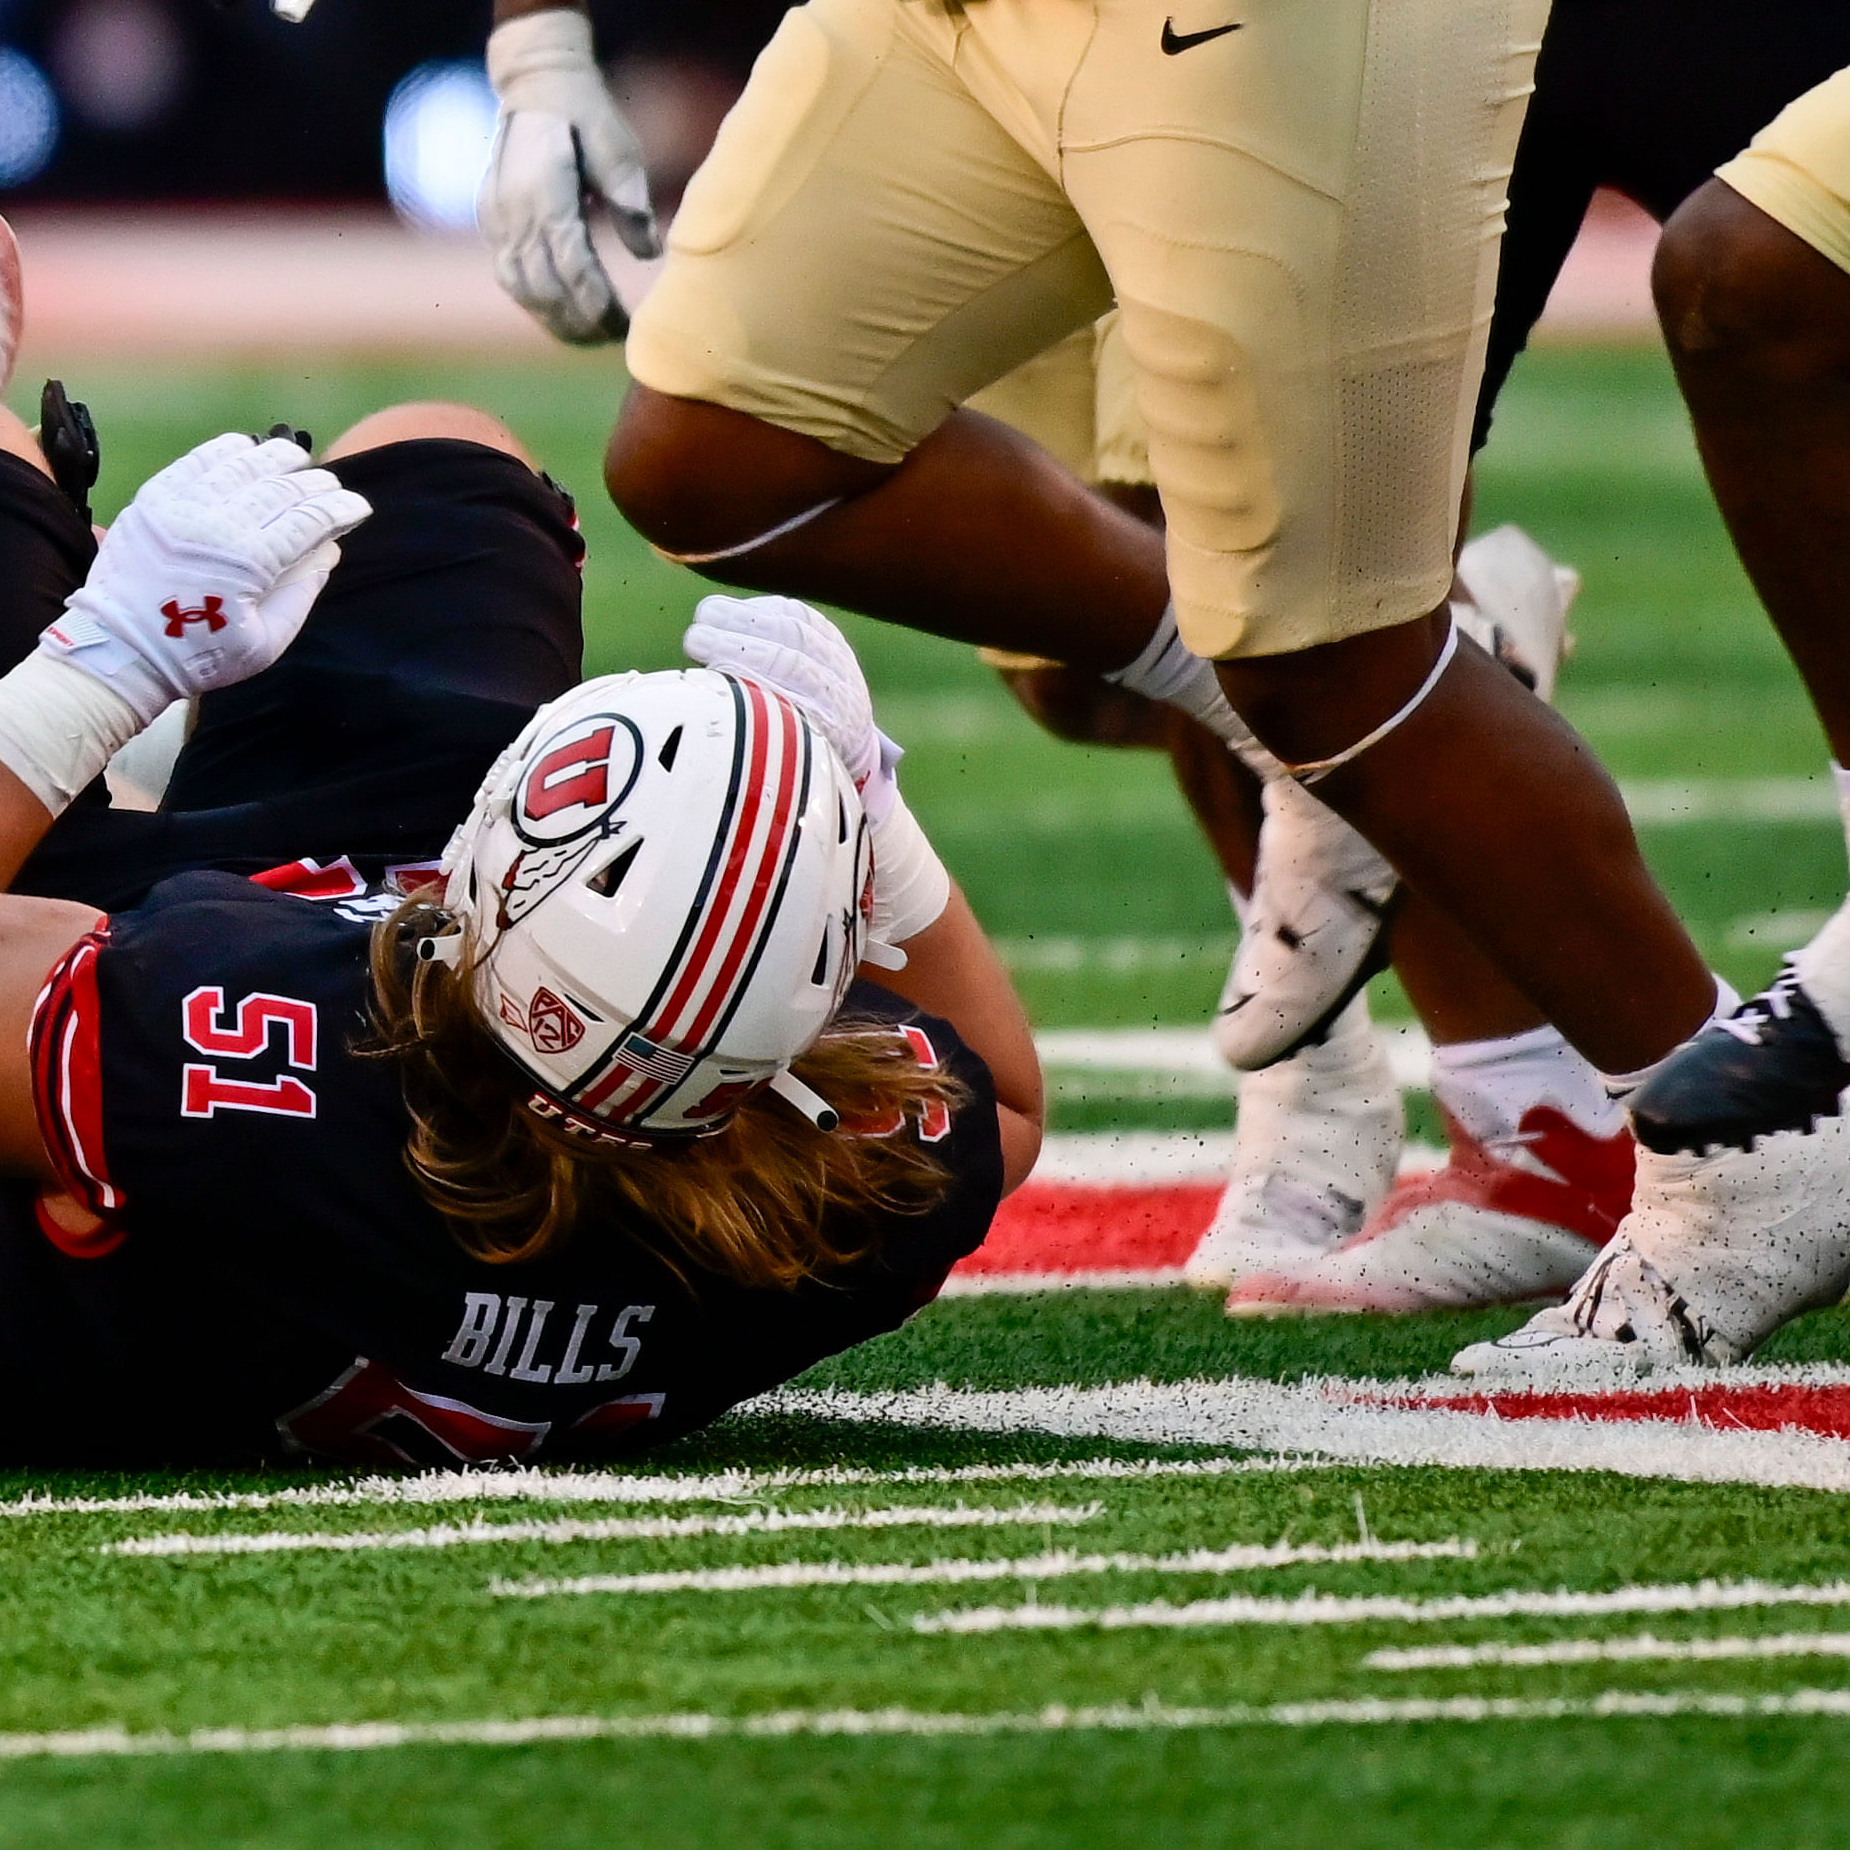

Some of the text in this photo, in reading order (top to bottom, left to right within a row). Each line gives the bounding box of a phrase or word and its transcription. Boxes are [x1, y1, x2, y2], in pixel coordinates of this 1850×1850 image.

[524, 726, 615, 821] U
[180, 985, 318, 1120] 51
[440, 1290, 656, 1385] BILLS
